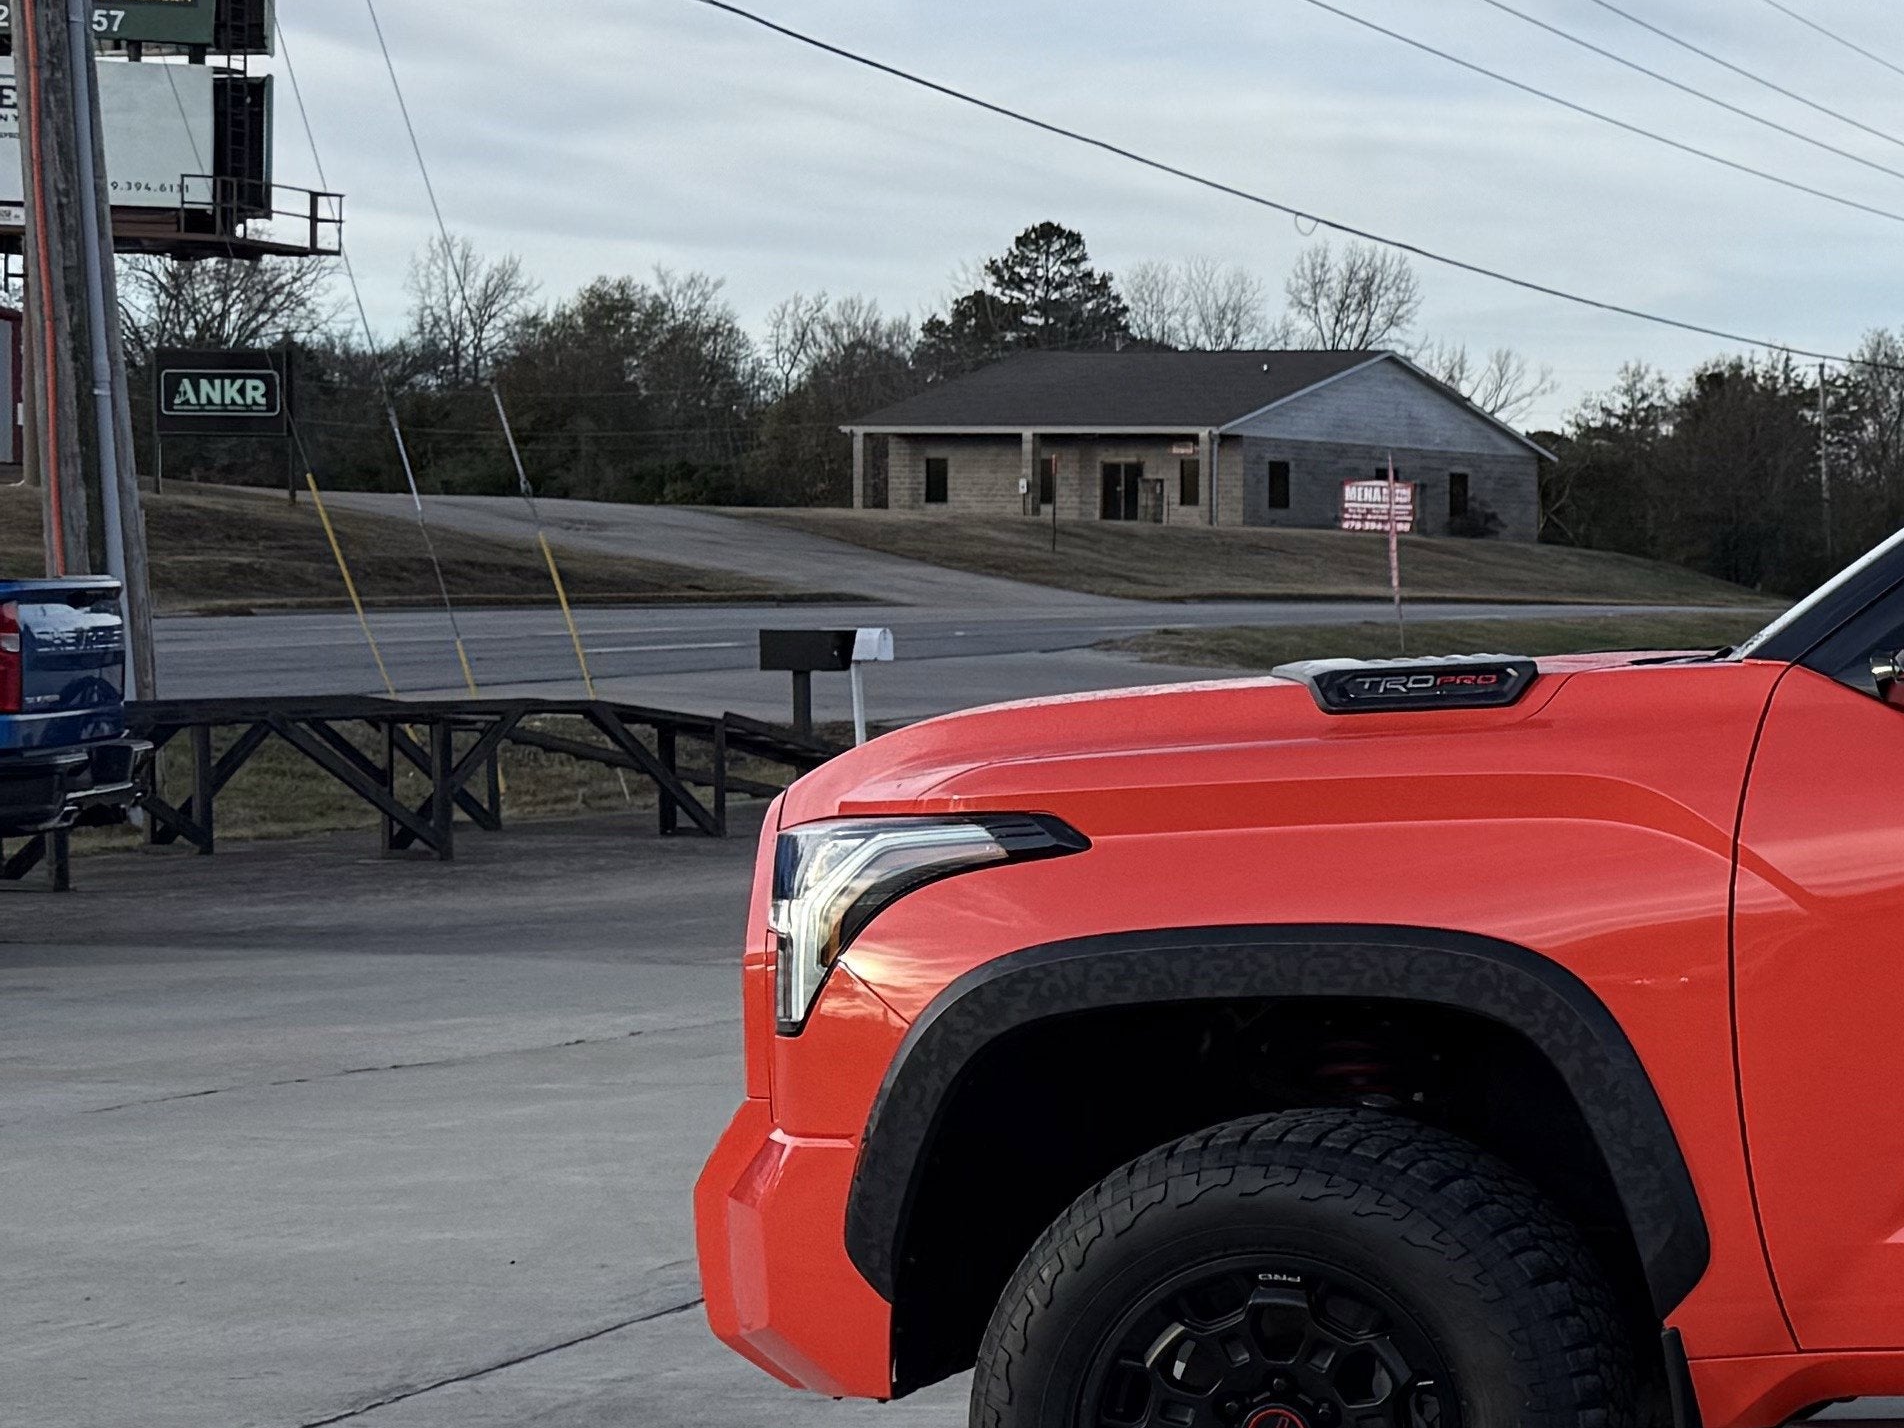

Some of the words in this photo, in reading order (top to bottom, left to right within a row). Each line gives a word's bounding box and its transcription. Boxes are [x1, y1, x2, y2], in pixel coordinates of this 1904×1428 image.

[173, 378, 267, 405] ANKR
[1356, 674, 1435, 693] TRD
[1436, 674, 1497, 686] PRO
